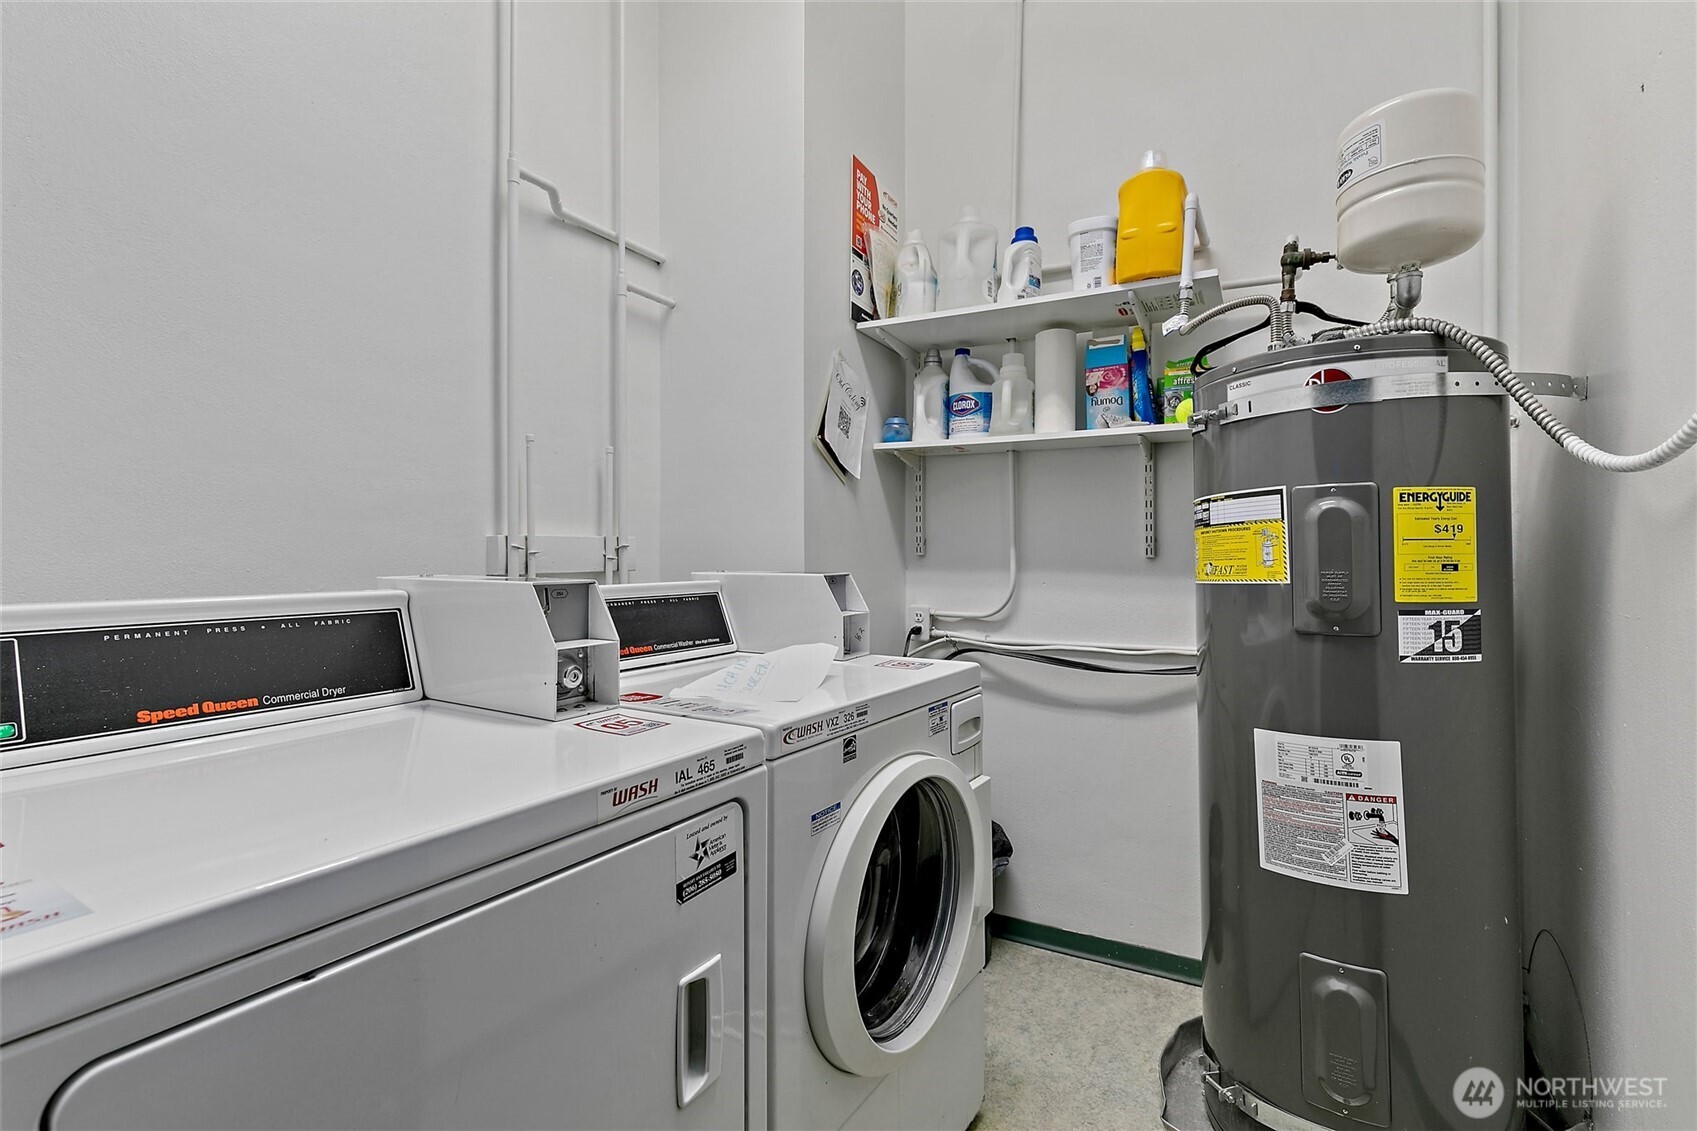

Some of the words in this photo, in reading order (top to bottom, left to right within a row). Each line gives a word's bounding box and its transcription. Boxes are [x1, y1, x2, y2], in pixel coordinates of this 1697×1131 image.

[856, 168, 868, 186] PAY
[856, 179, 872, 200] WITH
[856, 189, 872, 211] YOUR
[856, 200, 876, 225] PHONE
[1229, 380, 1252, 391] CLASSIC
[952, 399, 976, 411] CLOROX
[1090, 396, 1123, 407] Downy
[1399, 491, 1472, 503] ENERGYGUIDE
[1434, 523, 1464, 534] $419
[1213, 565, 1233, 575] FAST
[103, 629, 190, 641] PERMANENT
[206, 625, 247, 634] PRESS
[314, 618, 352, 627] FABRIC
[1427, 620, 1463, 653] 15
[629, 645, 653, 654] Queen
[653, 642, 678, 651] Commercial
[136, 703, 199, 724] Speed
[202, 696, 259, 714] Queen
[262, 690, 320, 705] Commercial
[321, 685, 347, 700] Dryer
[797, 720, 824, 738] WASH
[825, 716, 839, 728] VXZ
[843, 711, 855, 723] 326
[612, 777, 659, 807] WASH
[674, 767, 693, 785] IAL
[697, 759, 716, 776] 465
[1357, 795, 1394, 804] DANGER
[701, 823, 710, 832] and
[723, 814, 729, 822] by
[710, 833, 727, 844] American
